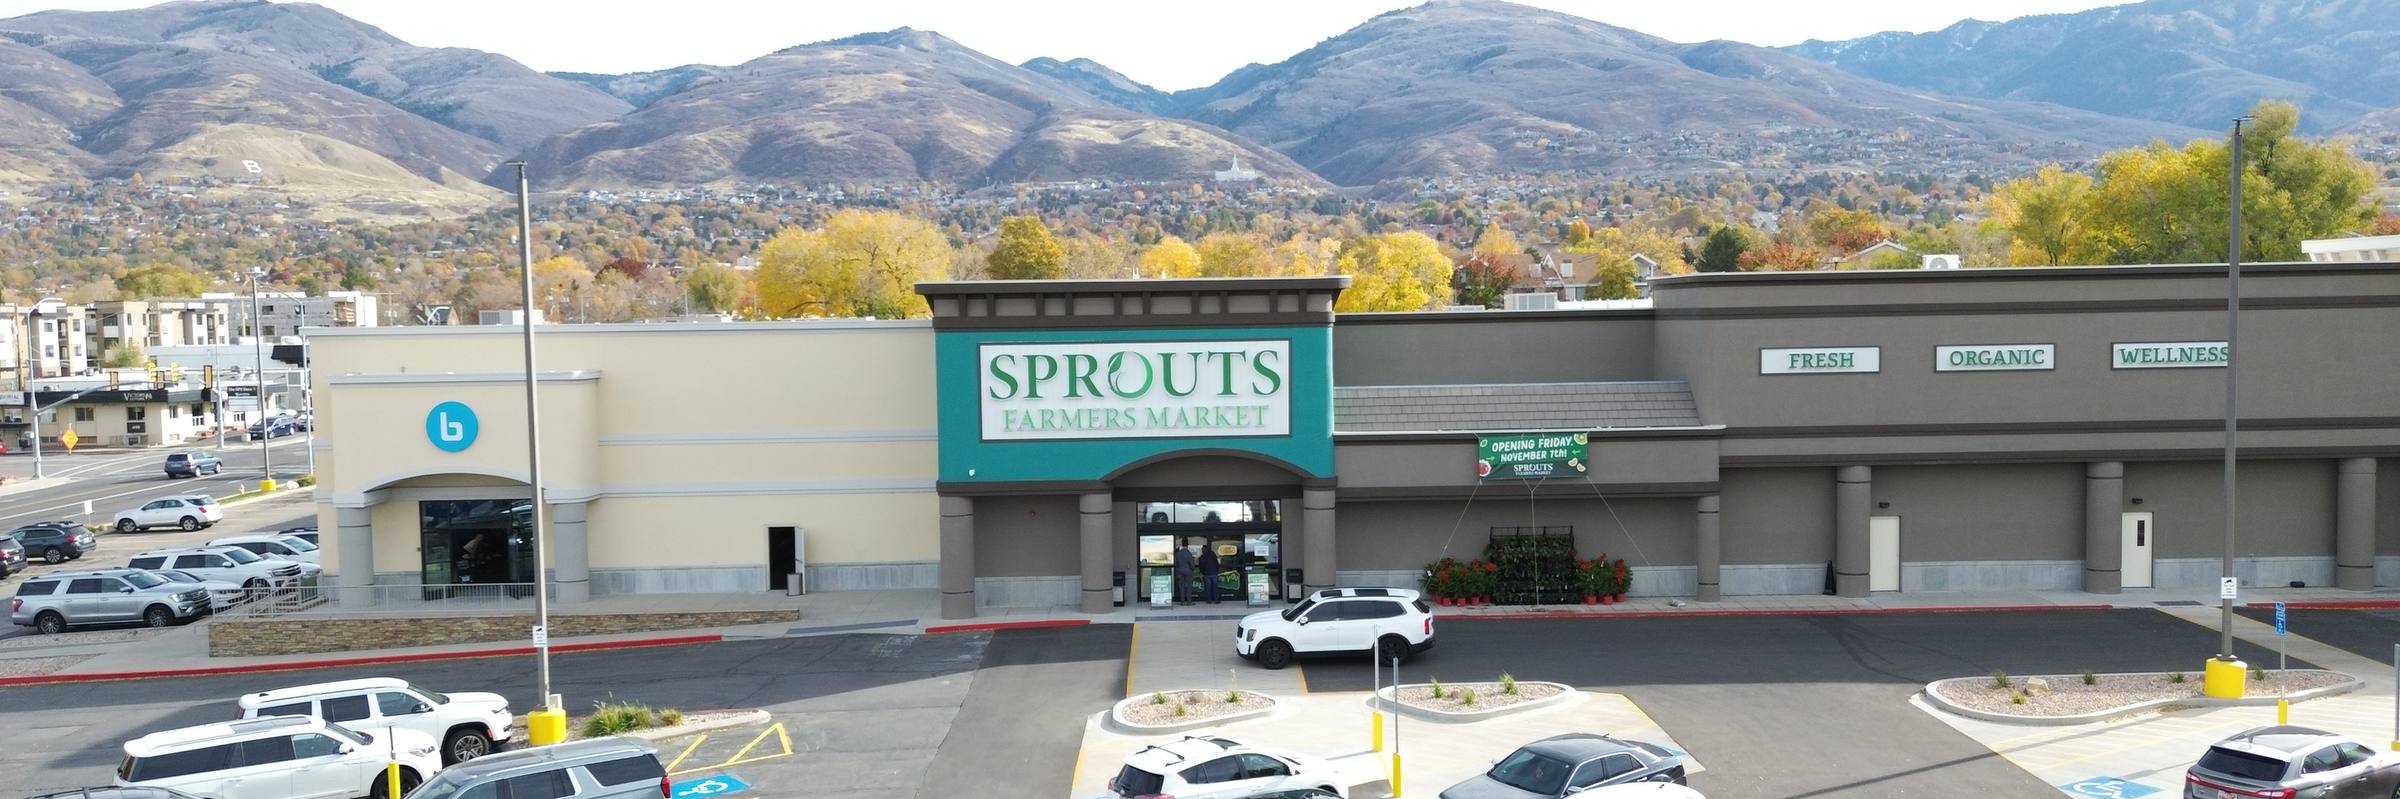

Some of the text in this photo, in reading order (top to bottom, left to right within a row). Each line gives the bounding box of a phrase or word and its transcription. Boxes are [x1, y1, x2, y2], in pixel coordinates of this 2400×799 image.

[241, 160, 262, 173] B
[1789, 352, 1855, 369] FRESH
[1950, 349, 2045, 366] ORGANIC
[2120, 346, 2229, 363] WELLNESS
[989, 350, 1281, 400] SPROUTS
[440, 411, 464, 441] b
[1003, 405, 1269, 432] FARMERS MARKET
[1492, 440, 1535, 452] OPENING
[1500, 449, 1567, 462] NOVEMBER 7th!
[1513, 463, 1553, 472] SPROUTS
